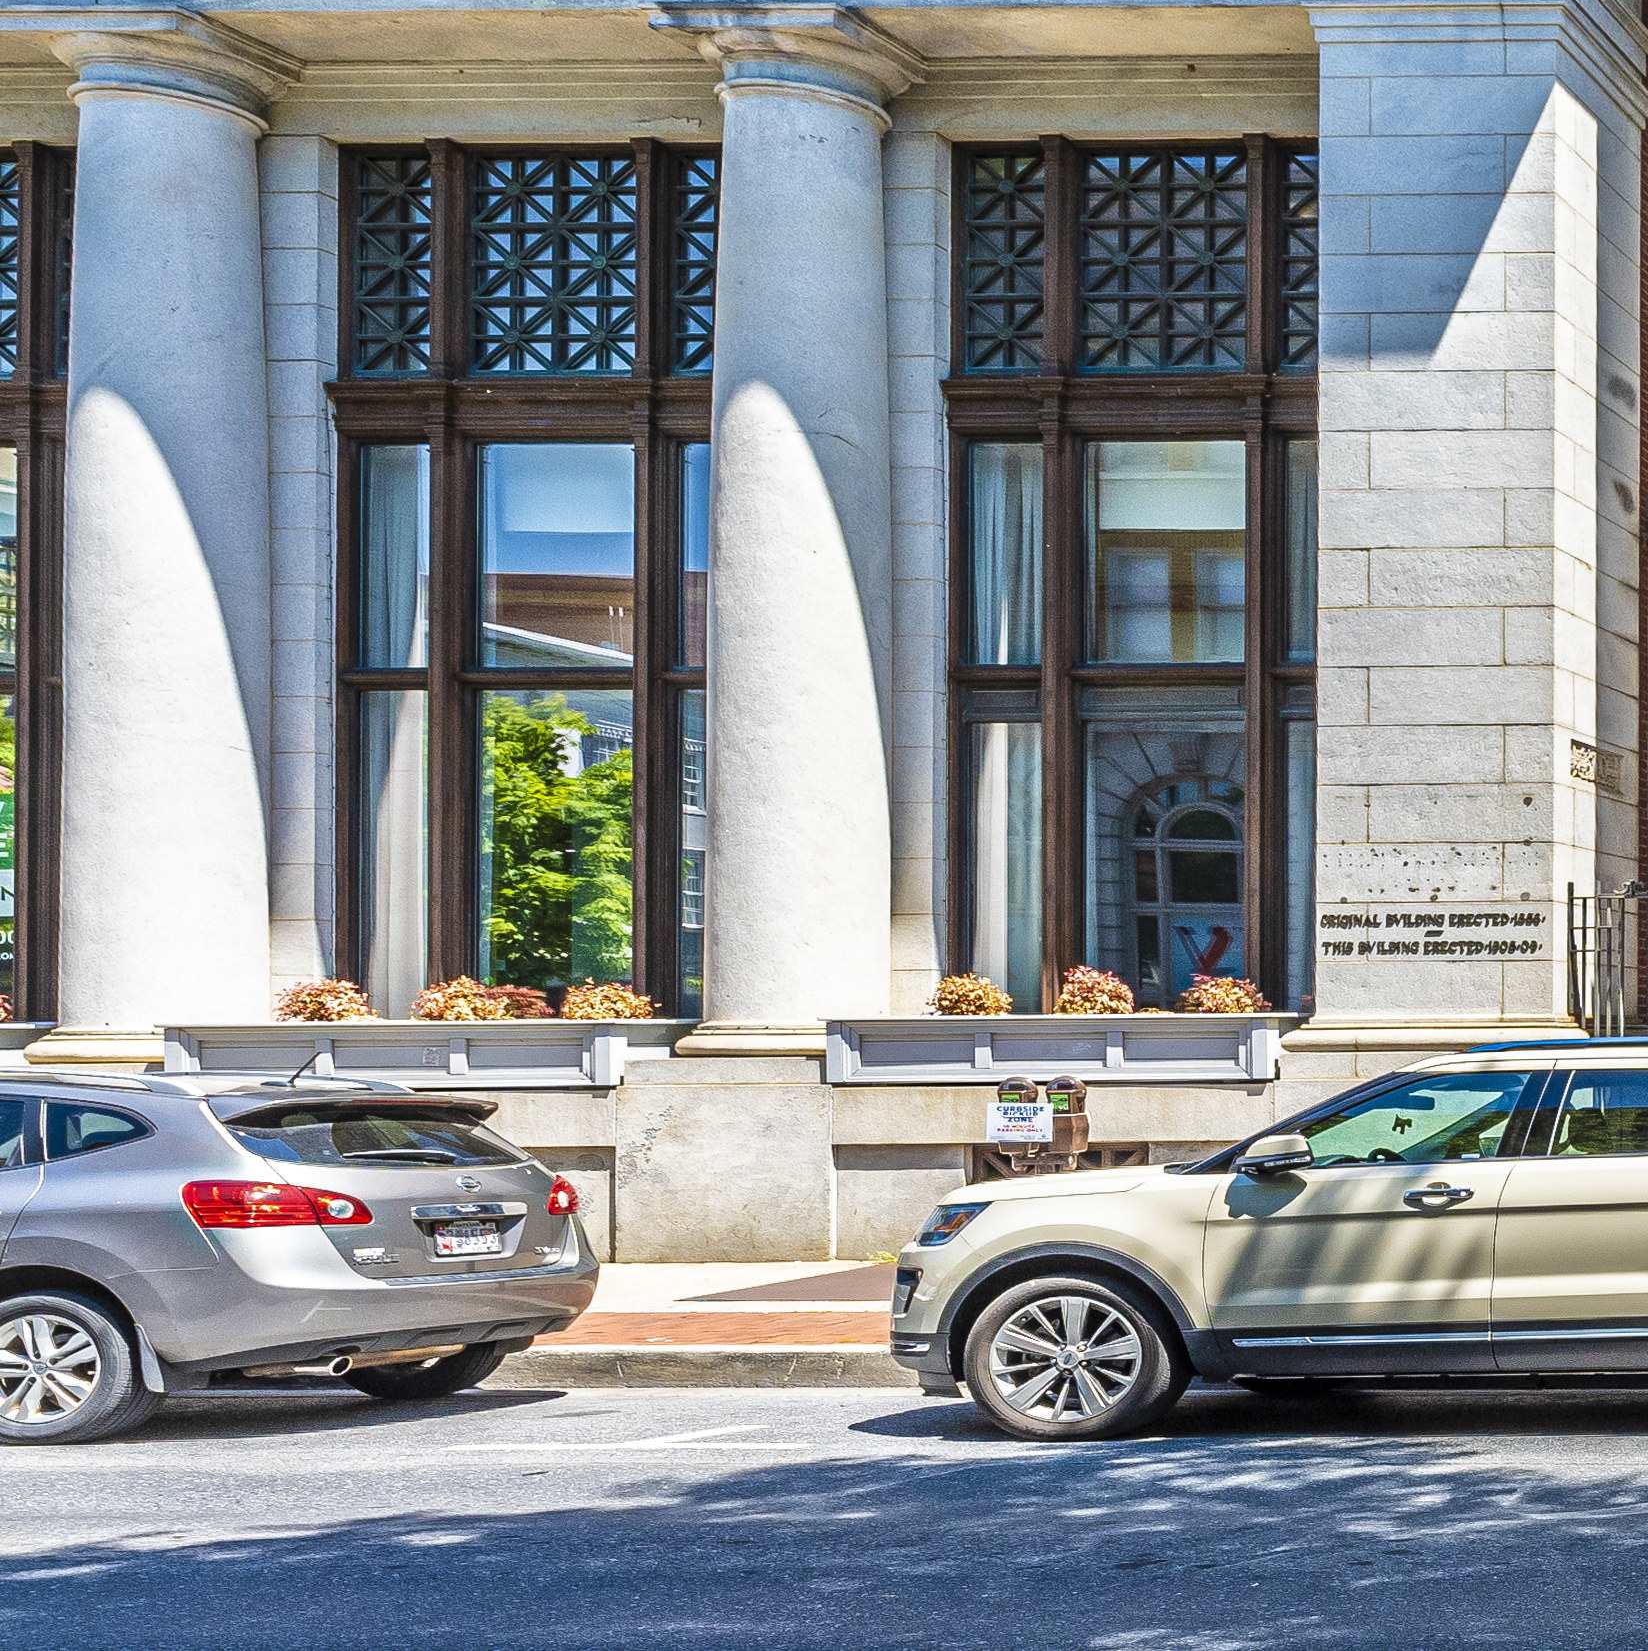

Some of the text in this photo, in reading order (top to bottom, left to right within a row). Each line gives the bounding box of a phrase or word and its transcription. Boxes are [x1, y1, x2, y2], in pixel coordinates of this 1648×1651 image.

[1320, 914, 1381, 929] ORIGINAL
[1448, 913, 1509, 928] ERECTED
[1321, 941, 1353, 956] THIS
[1423, 940, 1484, 956] ERECTED
